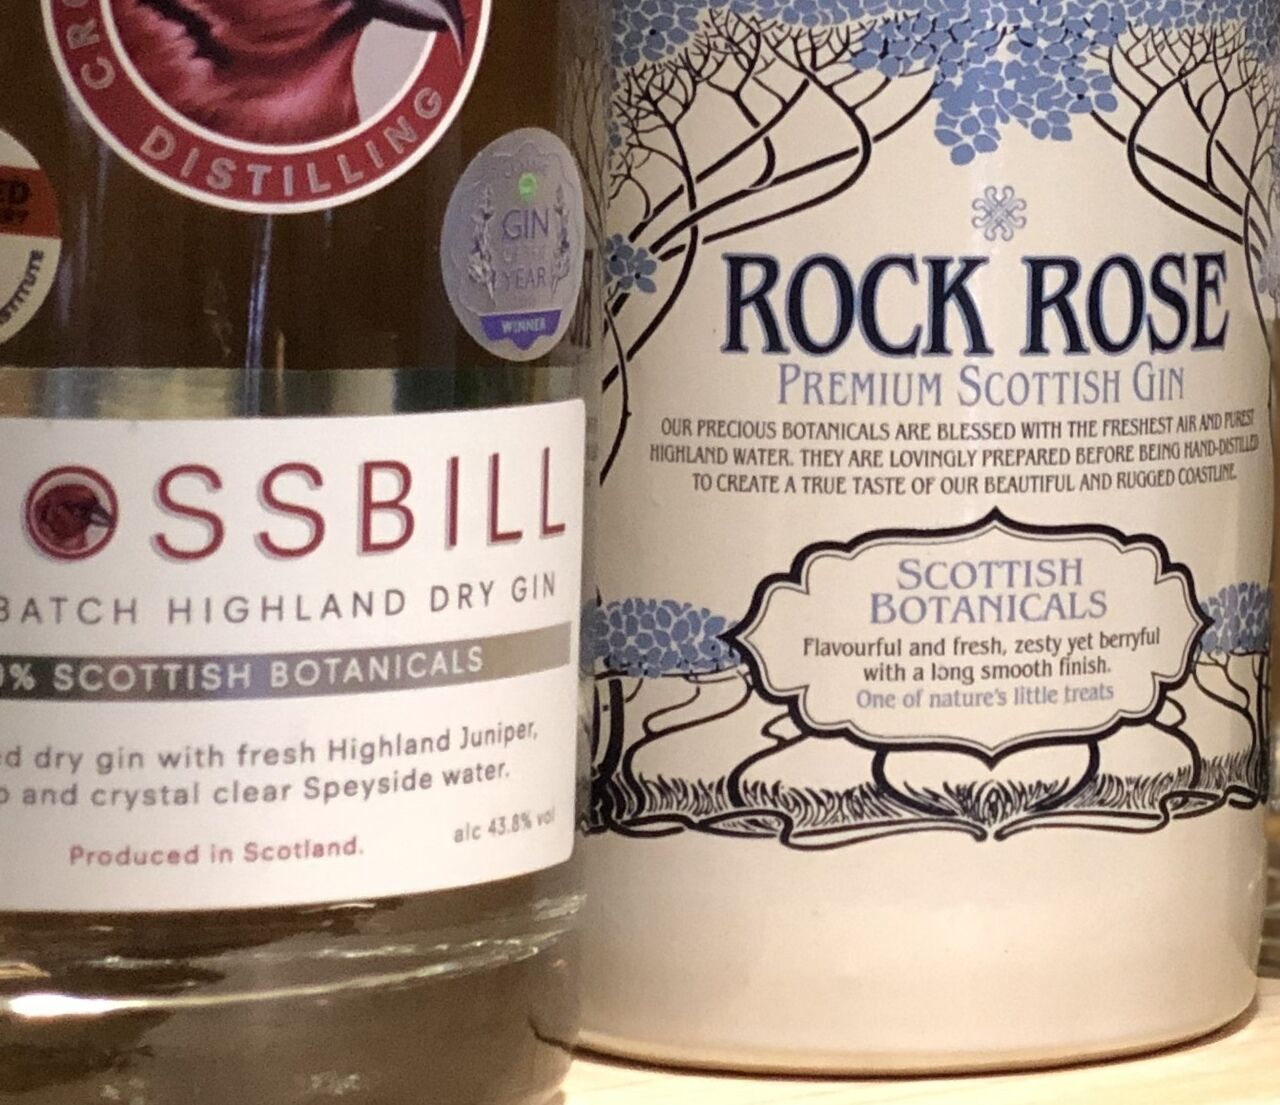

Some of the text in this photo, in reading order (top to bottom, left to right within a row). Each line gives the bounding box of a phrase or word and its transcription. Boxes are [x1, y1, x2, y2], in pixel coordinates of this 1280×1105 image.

[140, 85, 443, 196] DISTILLING
[502, 208, 549, 241] GIN
[503, 267, 547, 292] YEAR
[719, 250, 1232, 358] ROCK ROSE
[501, 317, 547, 334] WINNER
[778, 360, 1184, 407] PREMIUM SCOTTISH GIN
[661, 408, 1256, 441] OUR PRECIOUS BOTANICALS ARE BLESSED WITH THE FRESHEST AIR AND PUREST
[650, 432, 1259, 469] HIGHLAND WATER. THEY ARE LOVINGLY PREPARED BEFORE BEING HAND-DISTILLED
[692, 472, 712, 492] TO
[716, 472, 780, 494] CREATE
[784, 474, 797, 494] A
[802, 475, 846, 495] TRUE
[852, 476, 905, 495] TASTE
[911, 476, 935, 495] OF
[940, 475, 979, 495] OUR
[984, 472, 1075, 495] BEAUTIFUL
[1079, 471, 1112, 492] AND
[1116, 468, 1175, 490] RUGGED
[897, 558, 1083, 590] SCOTTISH
[168, 588, 405, 625] HIGHLAND
[430, 580, 494, 612] DRY
[511, 572, 556, 603] GIN
[869, 590, 1107, 625] BOTANICALS
[803, 626, 1160, 658] Flavourful and fresh, zesty yet berryful
[53, 662, 251, 692] SCOTTISH
[270, 646, 483, 689] BOTANICALS
[863, 656, 1111, 685] with a long smooth finish.
[856, 682, 1115, 709] One of nature's little treats
[34, 745, 83, 774] dry
[96, 746, 144, 775] gin
[158, 744, 224, 770] with
[237, 740, 315, 767] fresh
[328, 729, 450, 765] Highland
[459, 720, 538, 750] Juniper,
[22, 783, 77, 806] and
[90, 782, 200, 811] crystal
[213, 779, 291, 805] clear
[304, 768, 433, 805] Speyside
[442, 761, 510, 787] water.
[454, 806, 555, 844] alc 43.8% vol
[69, 836, 364, 867] Produced in Scotland.
